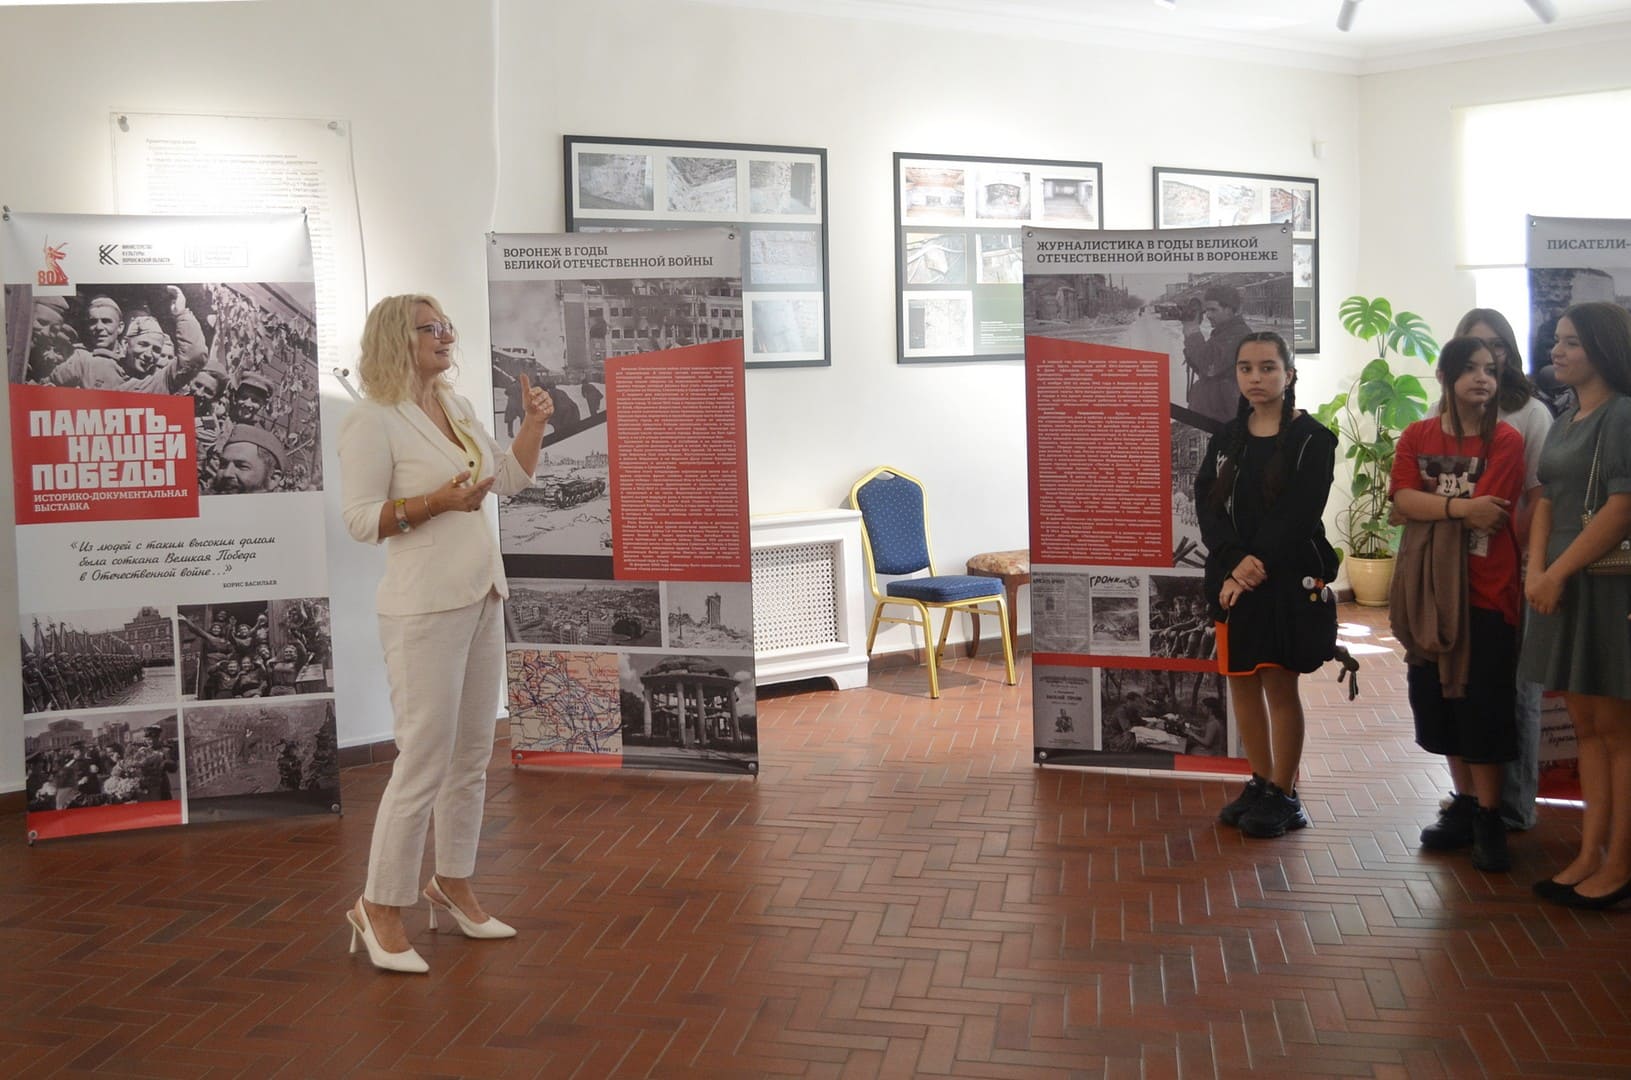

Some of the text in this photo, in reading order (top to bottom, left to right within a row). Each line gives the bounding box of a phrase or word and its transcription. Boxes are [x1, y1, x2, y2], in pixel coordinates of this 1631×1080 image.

[1037, 238, 1258, 251] ЖУРНАЛИСТИКА В ГОДЫ ВЕЛИКОЙ
[503, 246, 608, 258] ВОРОНЕЖ В ГОДЫ
[1036, 250, 1279, 263] ОТЕЧЕСТВЕННОЙ ВОЙНЫ В ВОРОНЕЖЕ
[504, 254, 713, 270] ВЕЛИКОЙ ОТЕЧЕСТВЕННОЙ ВОЙНЫ
[38, 271, 56, 284] 80
[30, 408, 167, 437] ПАМЯТЬ
[68, 425, 187, 462] НАШЕЙ
[32, 460, 176, 490] ПОБЕДЫ
[34, 489, 188, 502] ИСТОРИКО-ДОКУМЕНТАЛЬНАЯ
[34, 502, 90, 512] ВЫСТАВКА
[96, 541, 131, 554] людей
[136, 542, 142, 550] с
[146, 540, 184, 550] таким
[189, 537, 235, 549] высоким
[240, 536, 276, 548] долгом
[79, 550, 257, 567] была соткана Великая Победа
[80, 571, 86, 581] в
[92, 568, 176, 581] Отечественной
